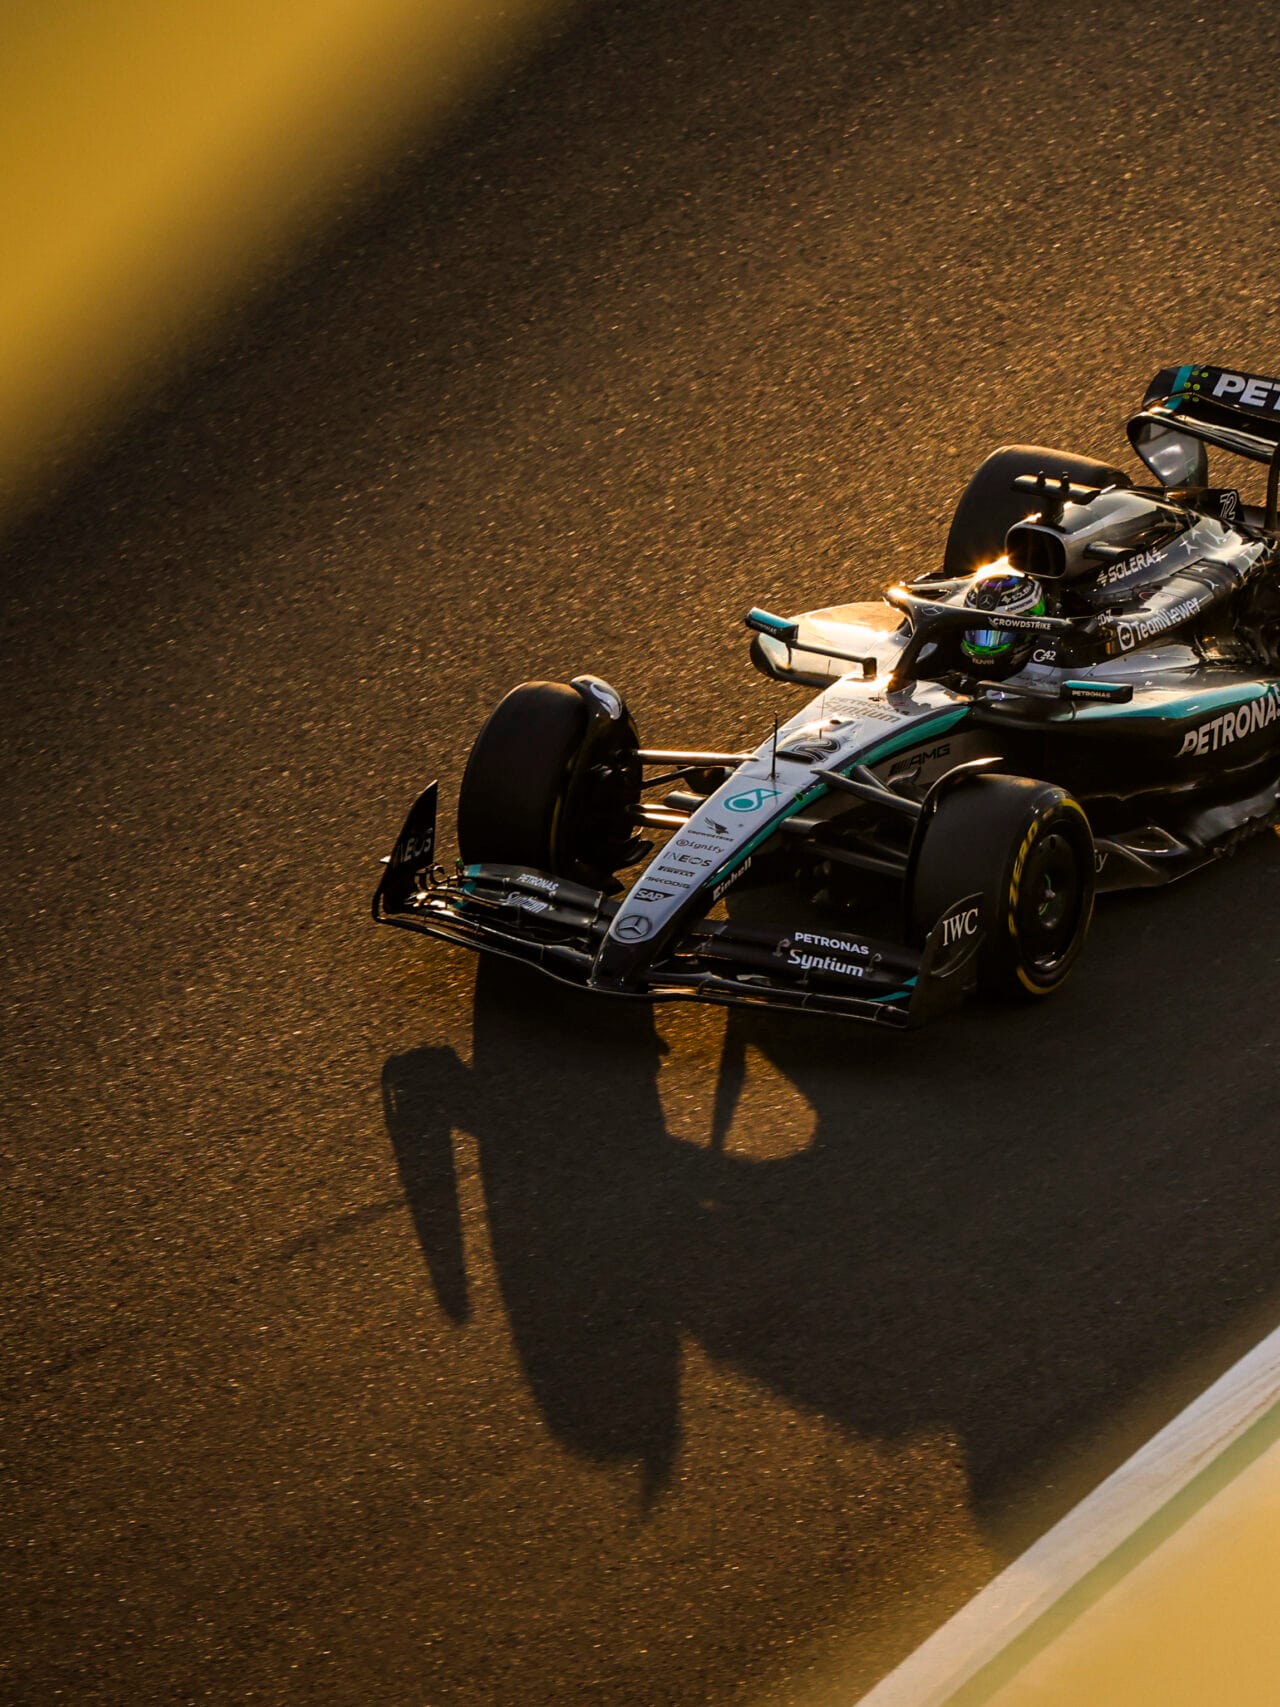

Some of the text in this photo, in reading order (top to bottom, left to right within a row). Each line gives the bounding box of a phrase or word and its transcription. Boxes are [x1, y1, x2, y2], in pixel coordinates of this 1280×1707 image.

[1107, 552, 1156, 584] SOLERA
[993, 618, 1052, 630] CROWDSTRIKE
[1132, 597, 1201, 641] TeamViewer
[1033, 649, 1057, 662] G42
[1072, 690, 1111, 698] PETRONAS
[909, 743, 951, 766] AMG
[663, 851, 712, 867] INEOS
[657, 866, 696, 877] PIRELLI
[713, 856, 752, 902] Einhell
[516, 874, 559, 891] PETRONAS
[636, 890, 665, 901] SAP
[942, 908, 979, 946] IWC
[794, 932, 869, 955] PETRONAS
[787, 949, 865, 977] Syntium
